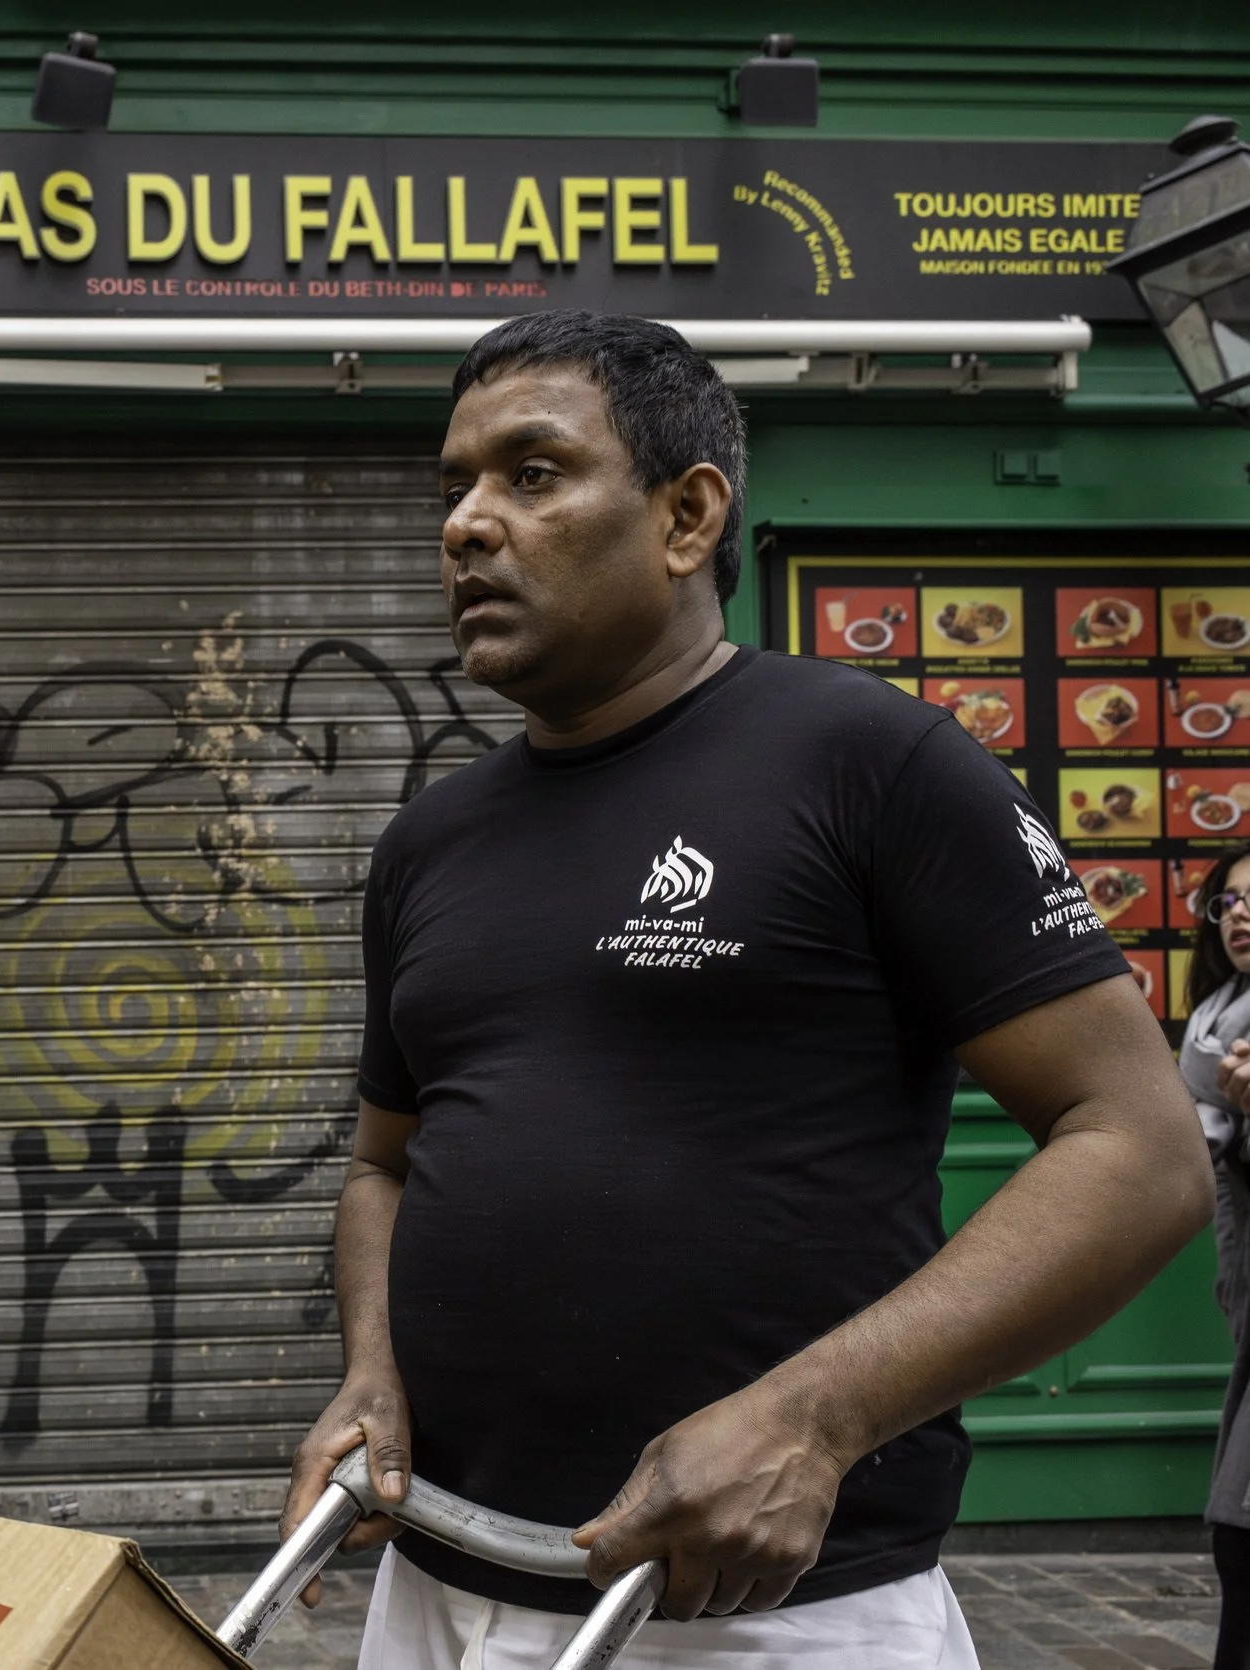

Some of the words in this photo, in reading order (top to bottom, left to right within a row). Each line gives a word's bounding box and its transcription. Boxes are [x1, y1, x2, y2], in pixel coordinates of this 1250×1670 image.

[733, 185, 758, 205] By
[761, 191, 809, 232] Lenny
[894, 192, 1057, 218] TOUJOURS
[1062, 193, 1142, 219] IMITE
[127, 172, 251, 264] DU
[284, 175, 720, 264] FALLAFEL
[911, 228, 1023, 253] JAMAIS
[1029, 229, 1125, 253] EGALE
[919, 259, 986, 275] MAISON
[987, 260, 1053, 275] FONDEE
[1056, 260, 1081, 275] EN
[86, 277, 147, 296] SOUS
[152, 278, 179, 296] LE
[184, 278, 301, 297] CONTROLE
[308, 280, 340, 298] DU
[345, 280, 445, 298] BETH-DIN
[485, 280, 547, 298] PARIS
[624, 914, 705, 933] mi-va-mi
[595, 935, 745, 957] L'AUTHENTIQUE
[624, 951, 703, 969] FALAFEL
